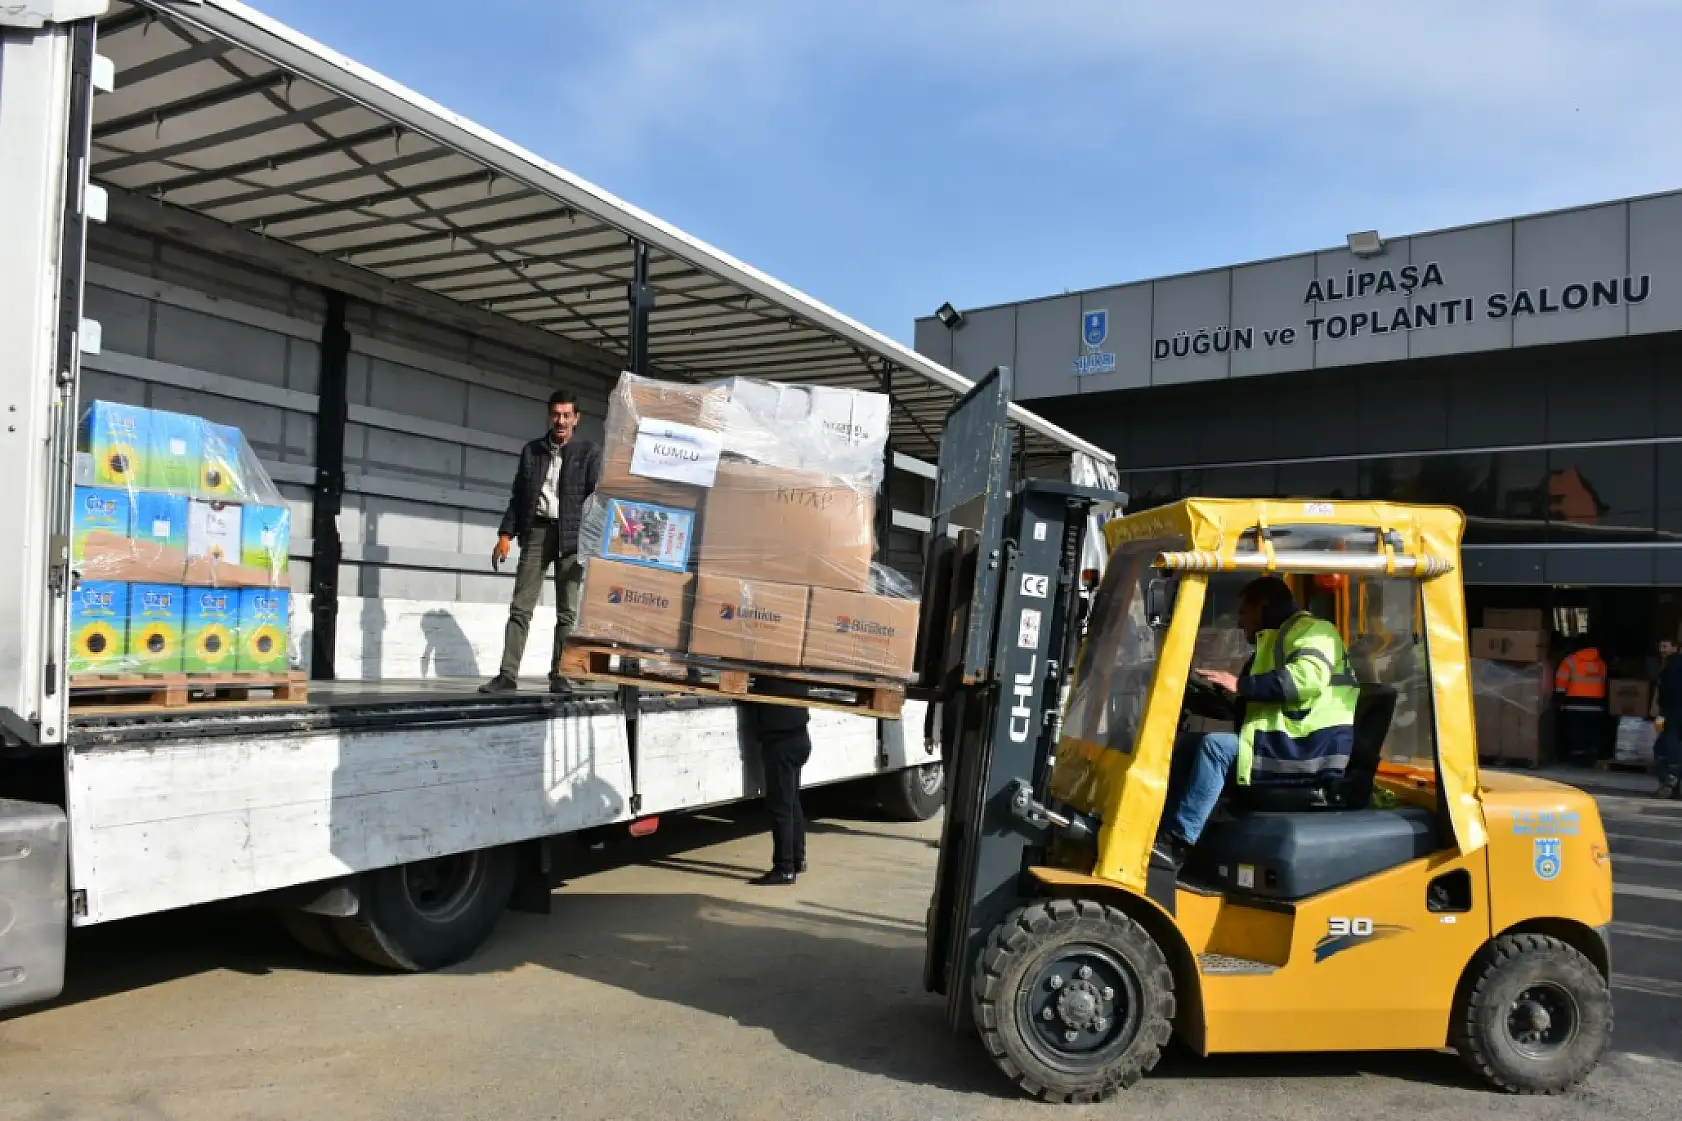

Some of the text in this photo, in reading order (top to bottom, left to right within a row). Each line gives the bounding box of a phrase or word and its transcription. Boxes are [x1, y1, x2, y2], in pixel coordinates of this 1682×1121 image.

[1304, 262, 1444, 304] ALİPAŞA
[1154, 275, 1650, 360] DÜĞÜN ve TOPLANTI SALONU
[653, 442, 700, 462] KUMLU
[624, 588, 669, 609] Birlikte
[851, 618, 895, 637] Birlikte
[1009, 653, 1037, 743] CHL
[1328, 917, 1374, 936] 30
